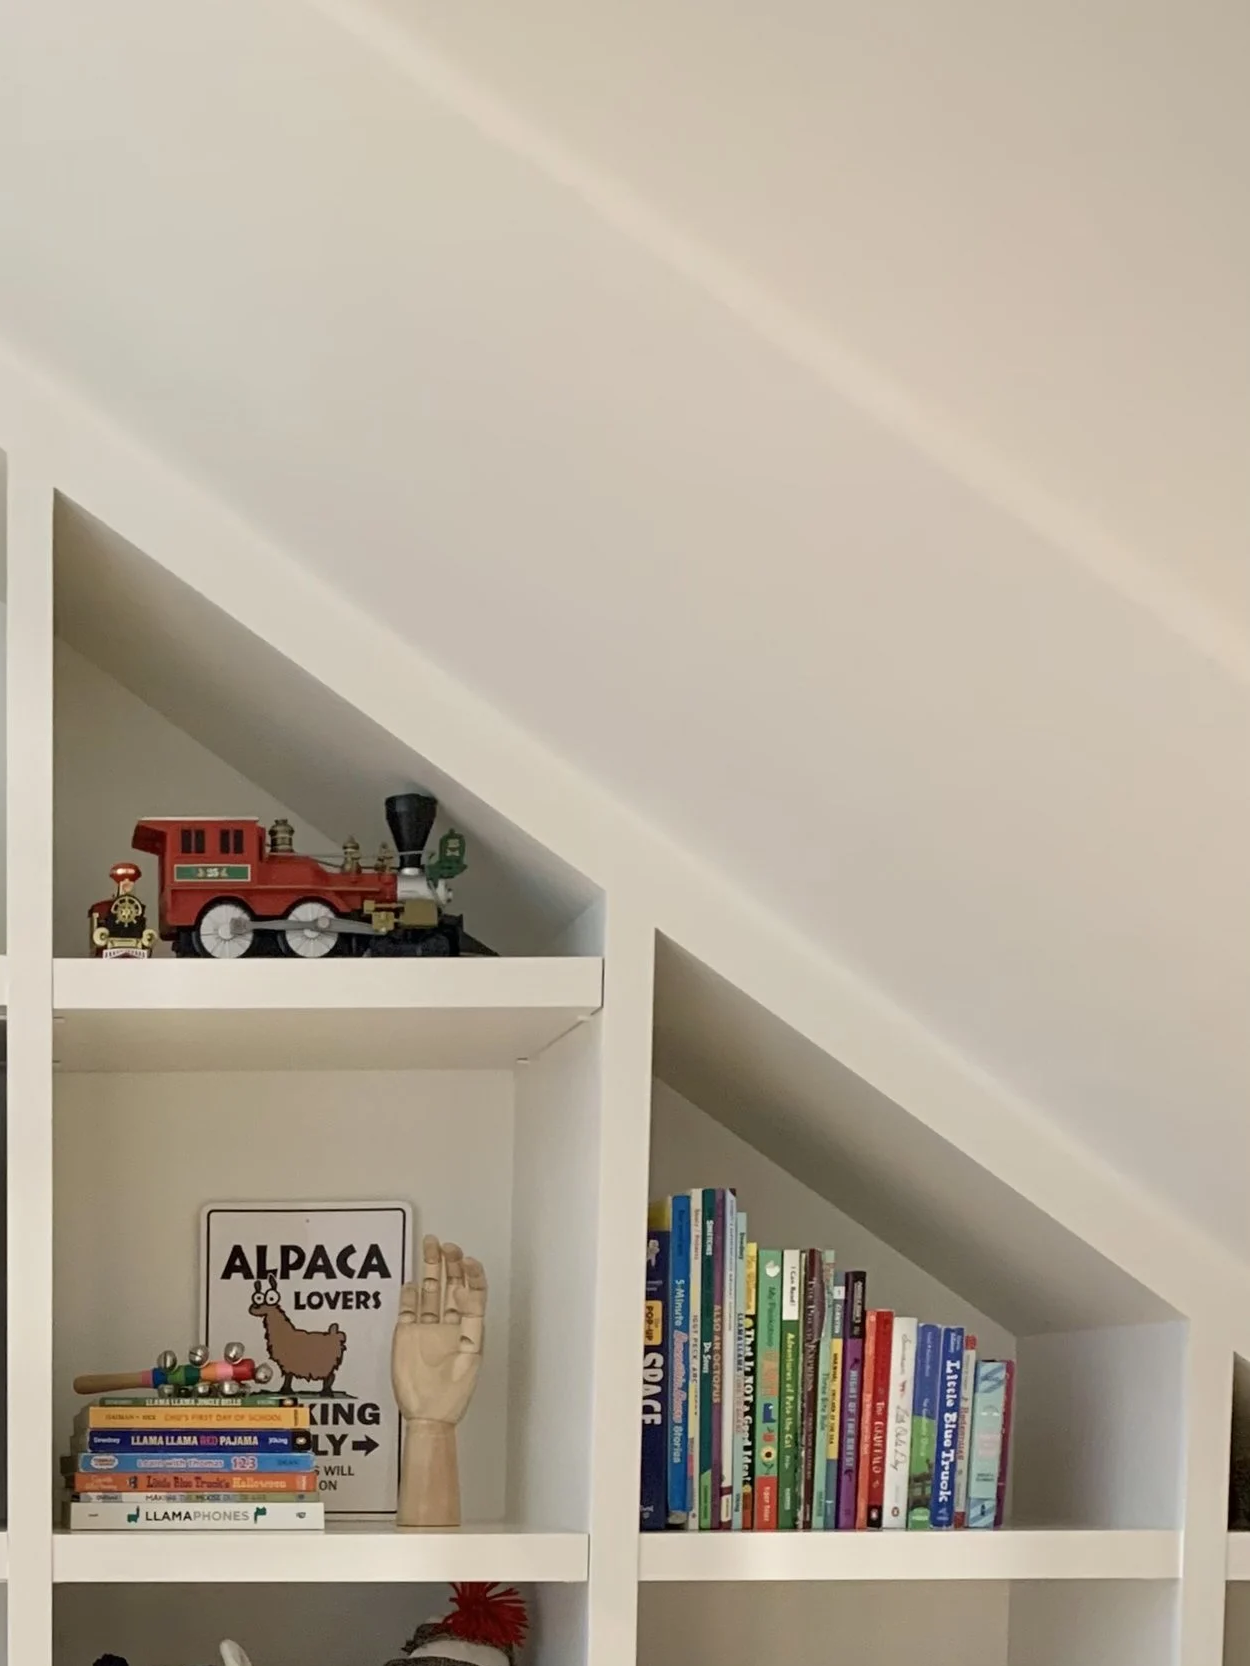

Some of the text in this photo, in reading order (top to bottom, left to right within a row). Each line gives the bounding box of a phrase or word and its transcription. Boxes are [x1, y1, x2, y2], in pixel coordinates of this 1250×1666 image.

[220, 1243, 392, 1280] ALPACA
[293, 1290, 382, 1310] LOVERS
[785, 1333, 796, 1380] Adventures
[672, 1279, 686, 1464] 5-Minute Stories
[643, 1352, 665, 1426] SPACE
[946, 1359, 961, 1408] Little
[309, 1402, 381, 1426] KING
[741, 1329, 755, 1483] That Is NOT Good Idea!
[785, 1395, 795, 1415] Pete
[216, 1412, 232, 1422] DAY
[234, 1412, 247, 1422] OF
[785, 1417, 795, 1431] the
[131, 1436, 259, 1446] LLAMA LLAMA RED PAJAMA
[784, 1433, 794, 1449] Cat
[943, 1411, 958, 1448] Blue
[312, 1433, 349, 1456] LY
[871, 1421, 885, 1474] GRUFFALO
[323, 1465, 355, 1476] WILL
[938, 1449, 955, 1503] Truck
[146, 1476, 287, 1489] Little Blue Truck's Halloween
[318, 1480, 338, 1491] ON
[145, 1511, 250, 1522] LLAMAPHONES
